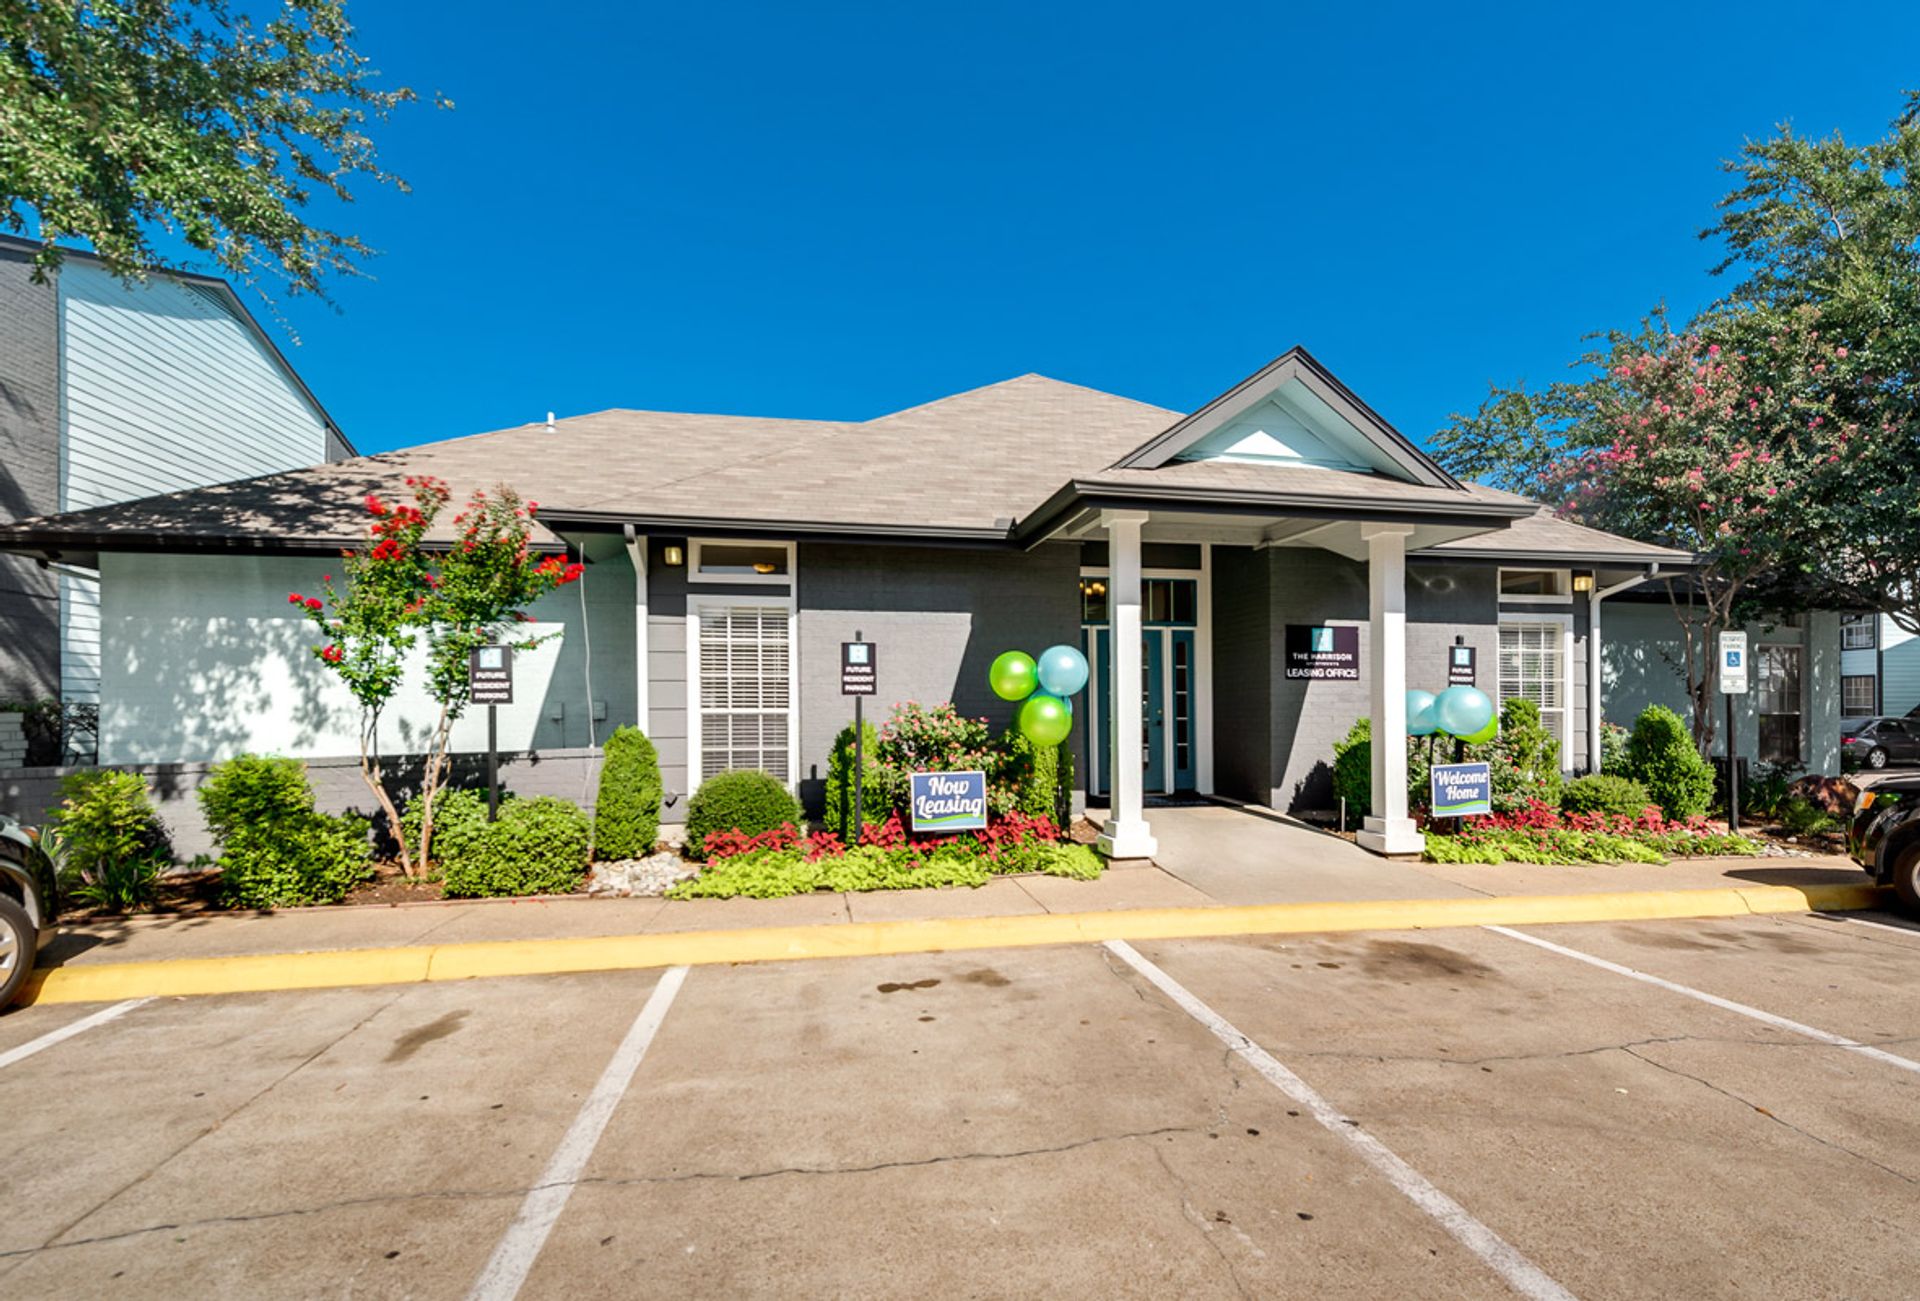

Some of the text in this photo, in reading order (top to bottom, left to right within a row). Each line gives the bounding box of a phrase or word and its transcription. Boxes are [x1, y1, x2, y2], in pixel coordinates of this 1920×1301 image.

[1292, 652, 1352, 661] THE HARRISON
[1287, 668, 1358, 678] LEASING OFFICE
[1435, 770, 1487, 786] Welcome
[928, 776, 969, 796] Now
[1445, 785, 1479, 800] Home
[916, 795, 982, 819] Leasing
